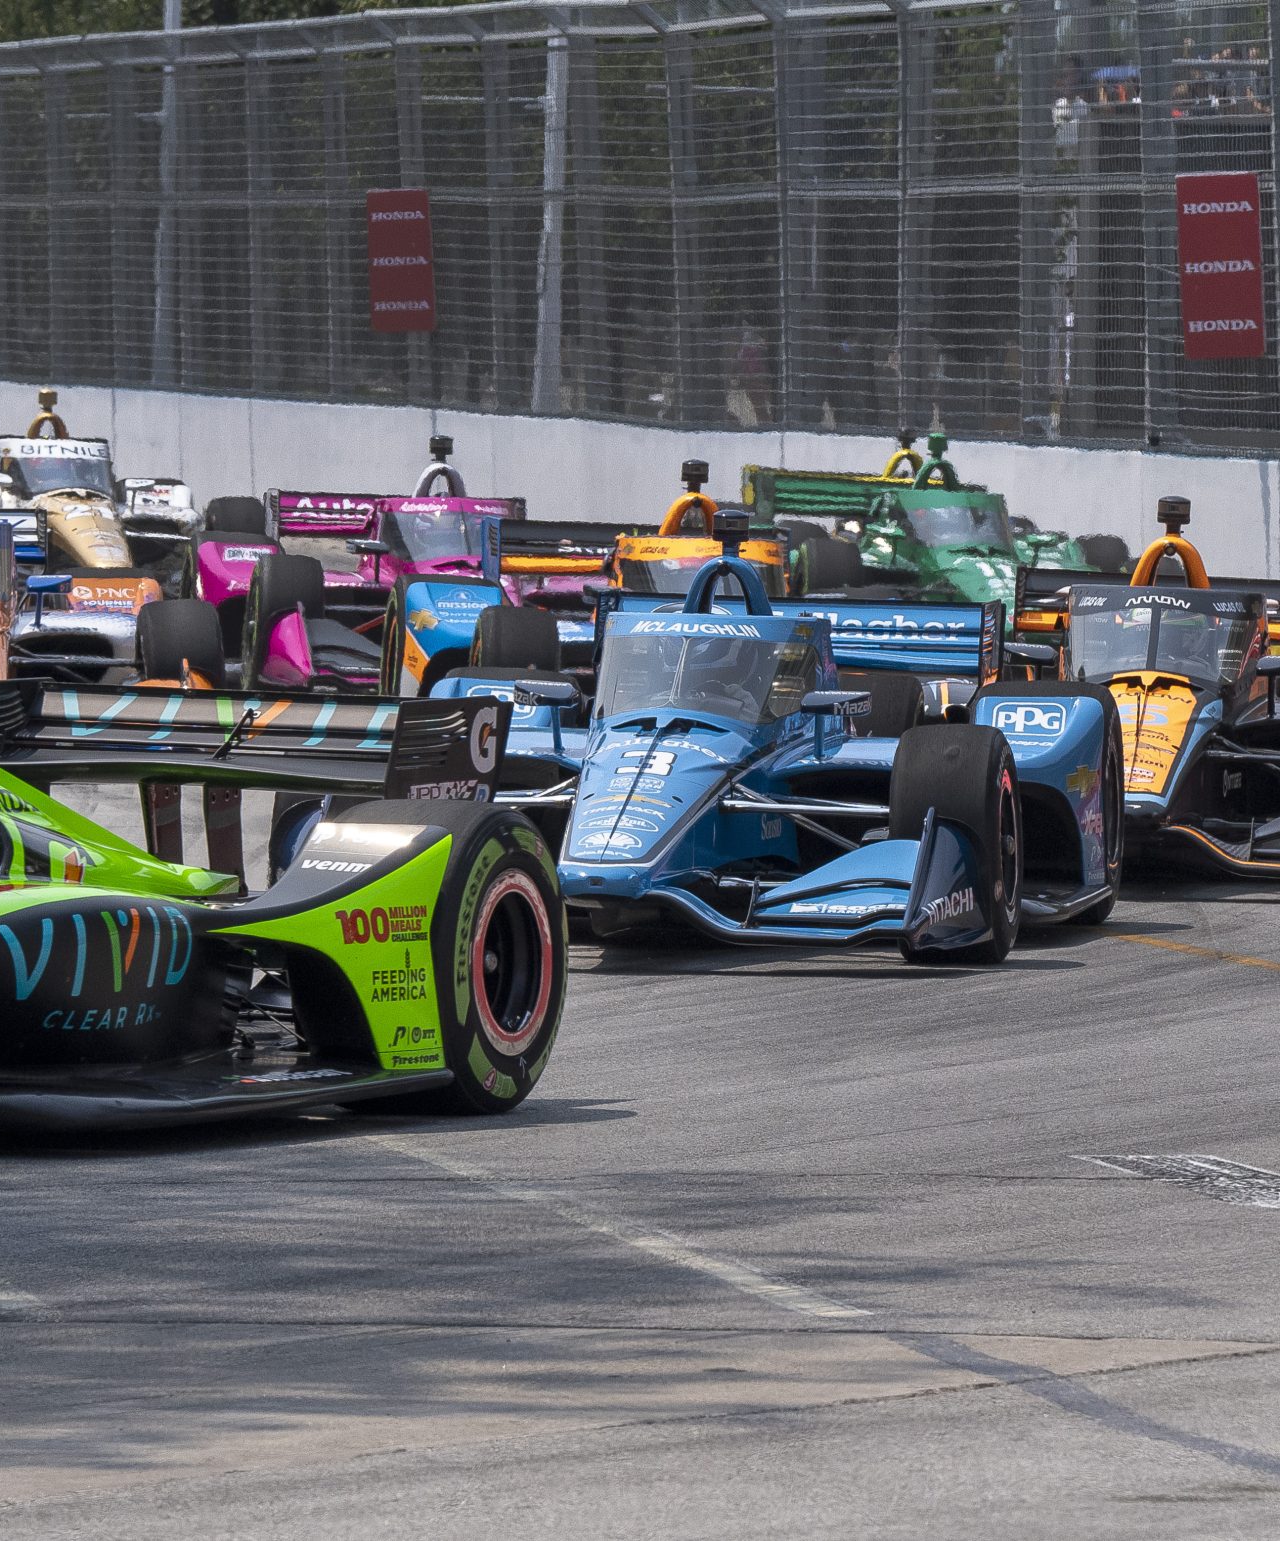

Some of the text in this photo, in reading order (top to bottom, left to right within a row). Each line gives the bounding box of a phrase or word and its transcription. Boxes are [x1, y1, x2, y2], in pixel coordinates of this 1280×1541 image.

[1183, 201, 1253, 214] HONDA
[371, 210, 425, 222] HONDA
[373, 256, 428, 266] HONDA
[1185, 260, 1255, 274] HONDA
[374, 301, 430, 311] HONDA
[1188, 319, 1258, 333] HONDA
[21, 444, 110, 459] BITNILE
[96, 588, 136, 598] PNC
[1079, 597, 1107, 607] LUCAS OIL
[1125, 595, 1191, 609] ARROW
[1212, 602, 1247, 613] LUCAS OIL
[630, 620, 762, 638] MCLAUGHLIN
[773, 611, 965, 641] lagher
[513, 690, 539, 706] azak
[998, 707, 1060, 732] PPG
[1119, 704, 1169, 725] 5
[615, 750, 677, 776] 3
[301, 859, 373, 873] venm
[389, 905, 427, 918] MILLION
[923, 887, 975, 925] HITACHI
[335, 905, 390, 944] 100
[390, 918, 422, 932] MEALS
[391, 931, 428, 942] CHALLENGE
[372, 967, 426, 985] FEEDING
[371, 985, 427, 1002] AMERICA
[43, 1008, 127, 1030] CLEAR
[391, 1053, 440, 1068] Firestone
